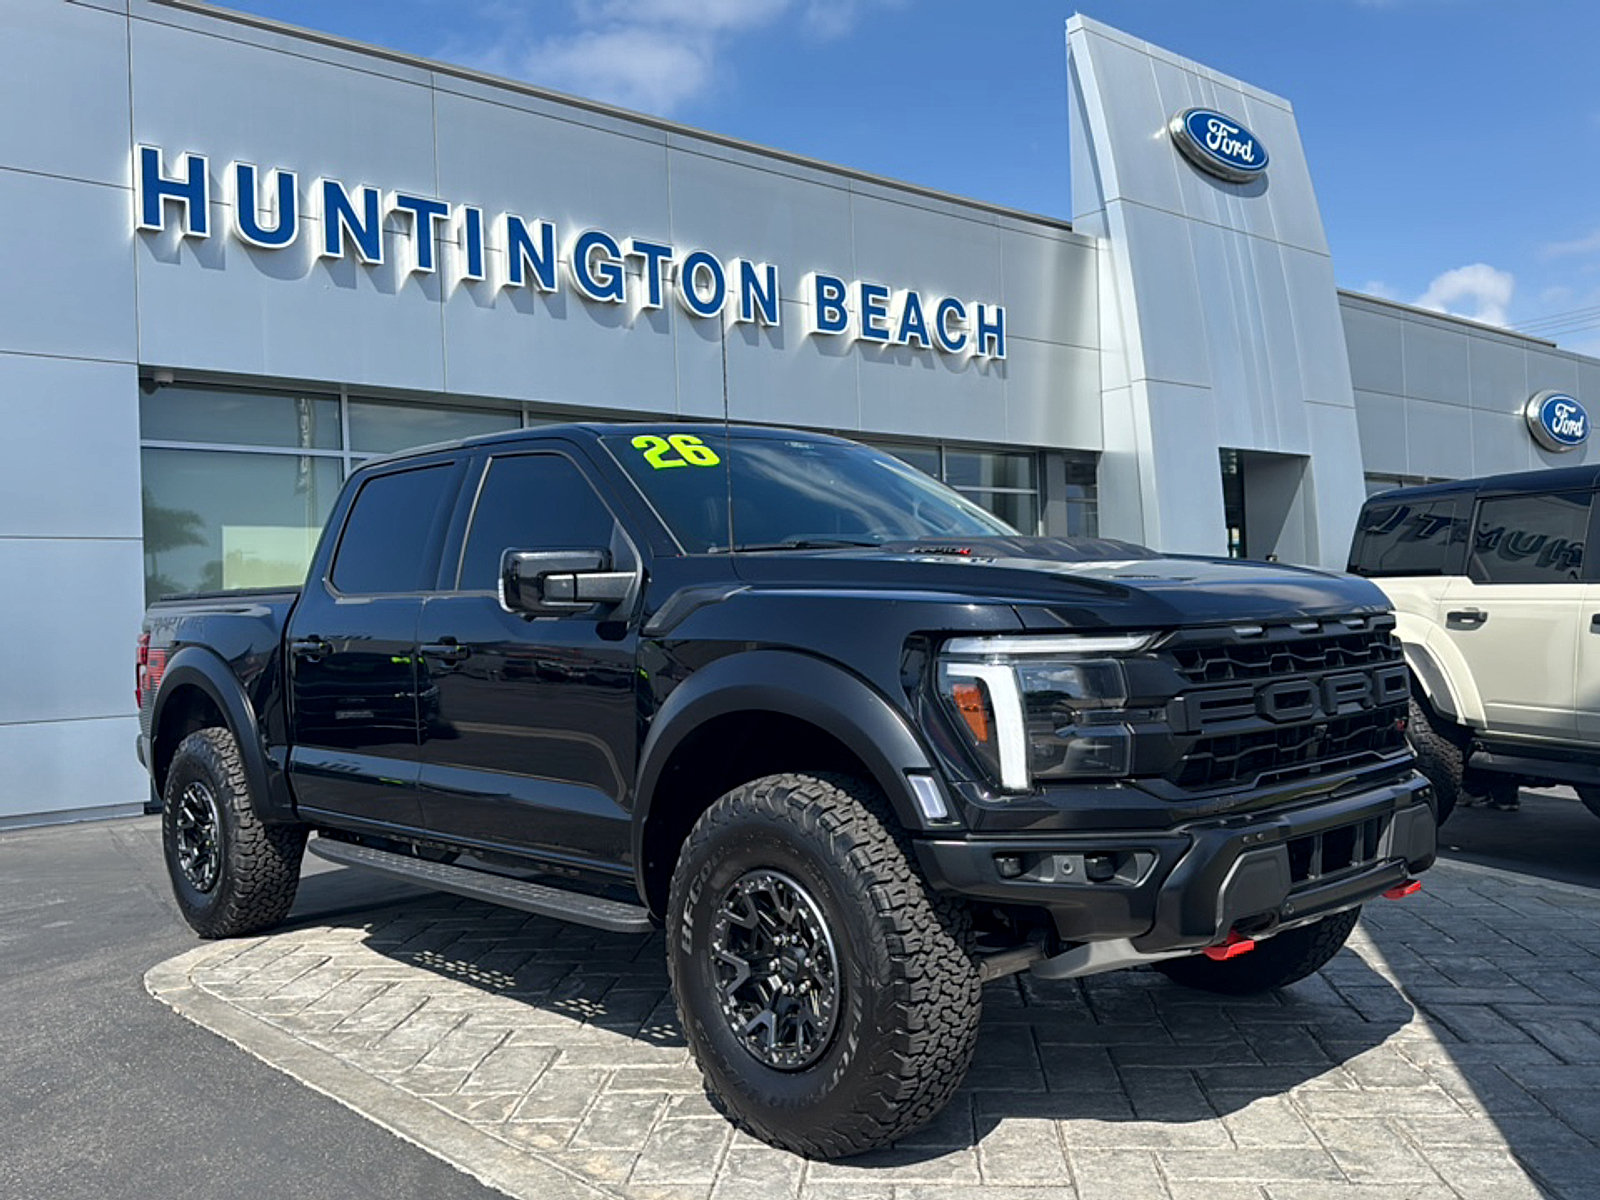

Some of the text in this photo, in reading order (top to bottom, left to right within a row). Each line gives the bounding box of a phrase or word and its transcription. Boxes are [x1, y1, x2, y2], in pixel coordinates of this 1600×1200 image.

[1206, 118, 1254, 163] Ford
[135, 143, 1006, 359] HUNTINGTON BEACH
[1551, 403, 1585, 438] Ford
[631, 434, 720, 470] 26
[1172, 665, 1411, 734] FORD
